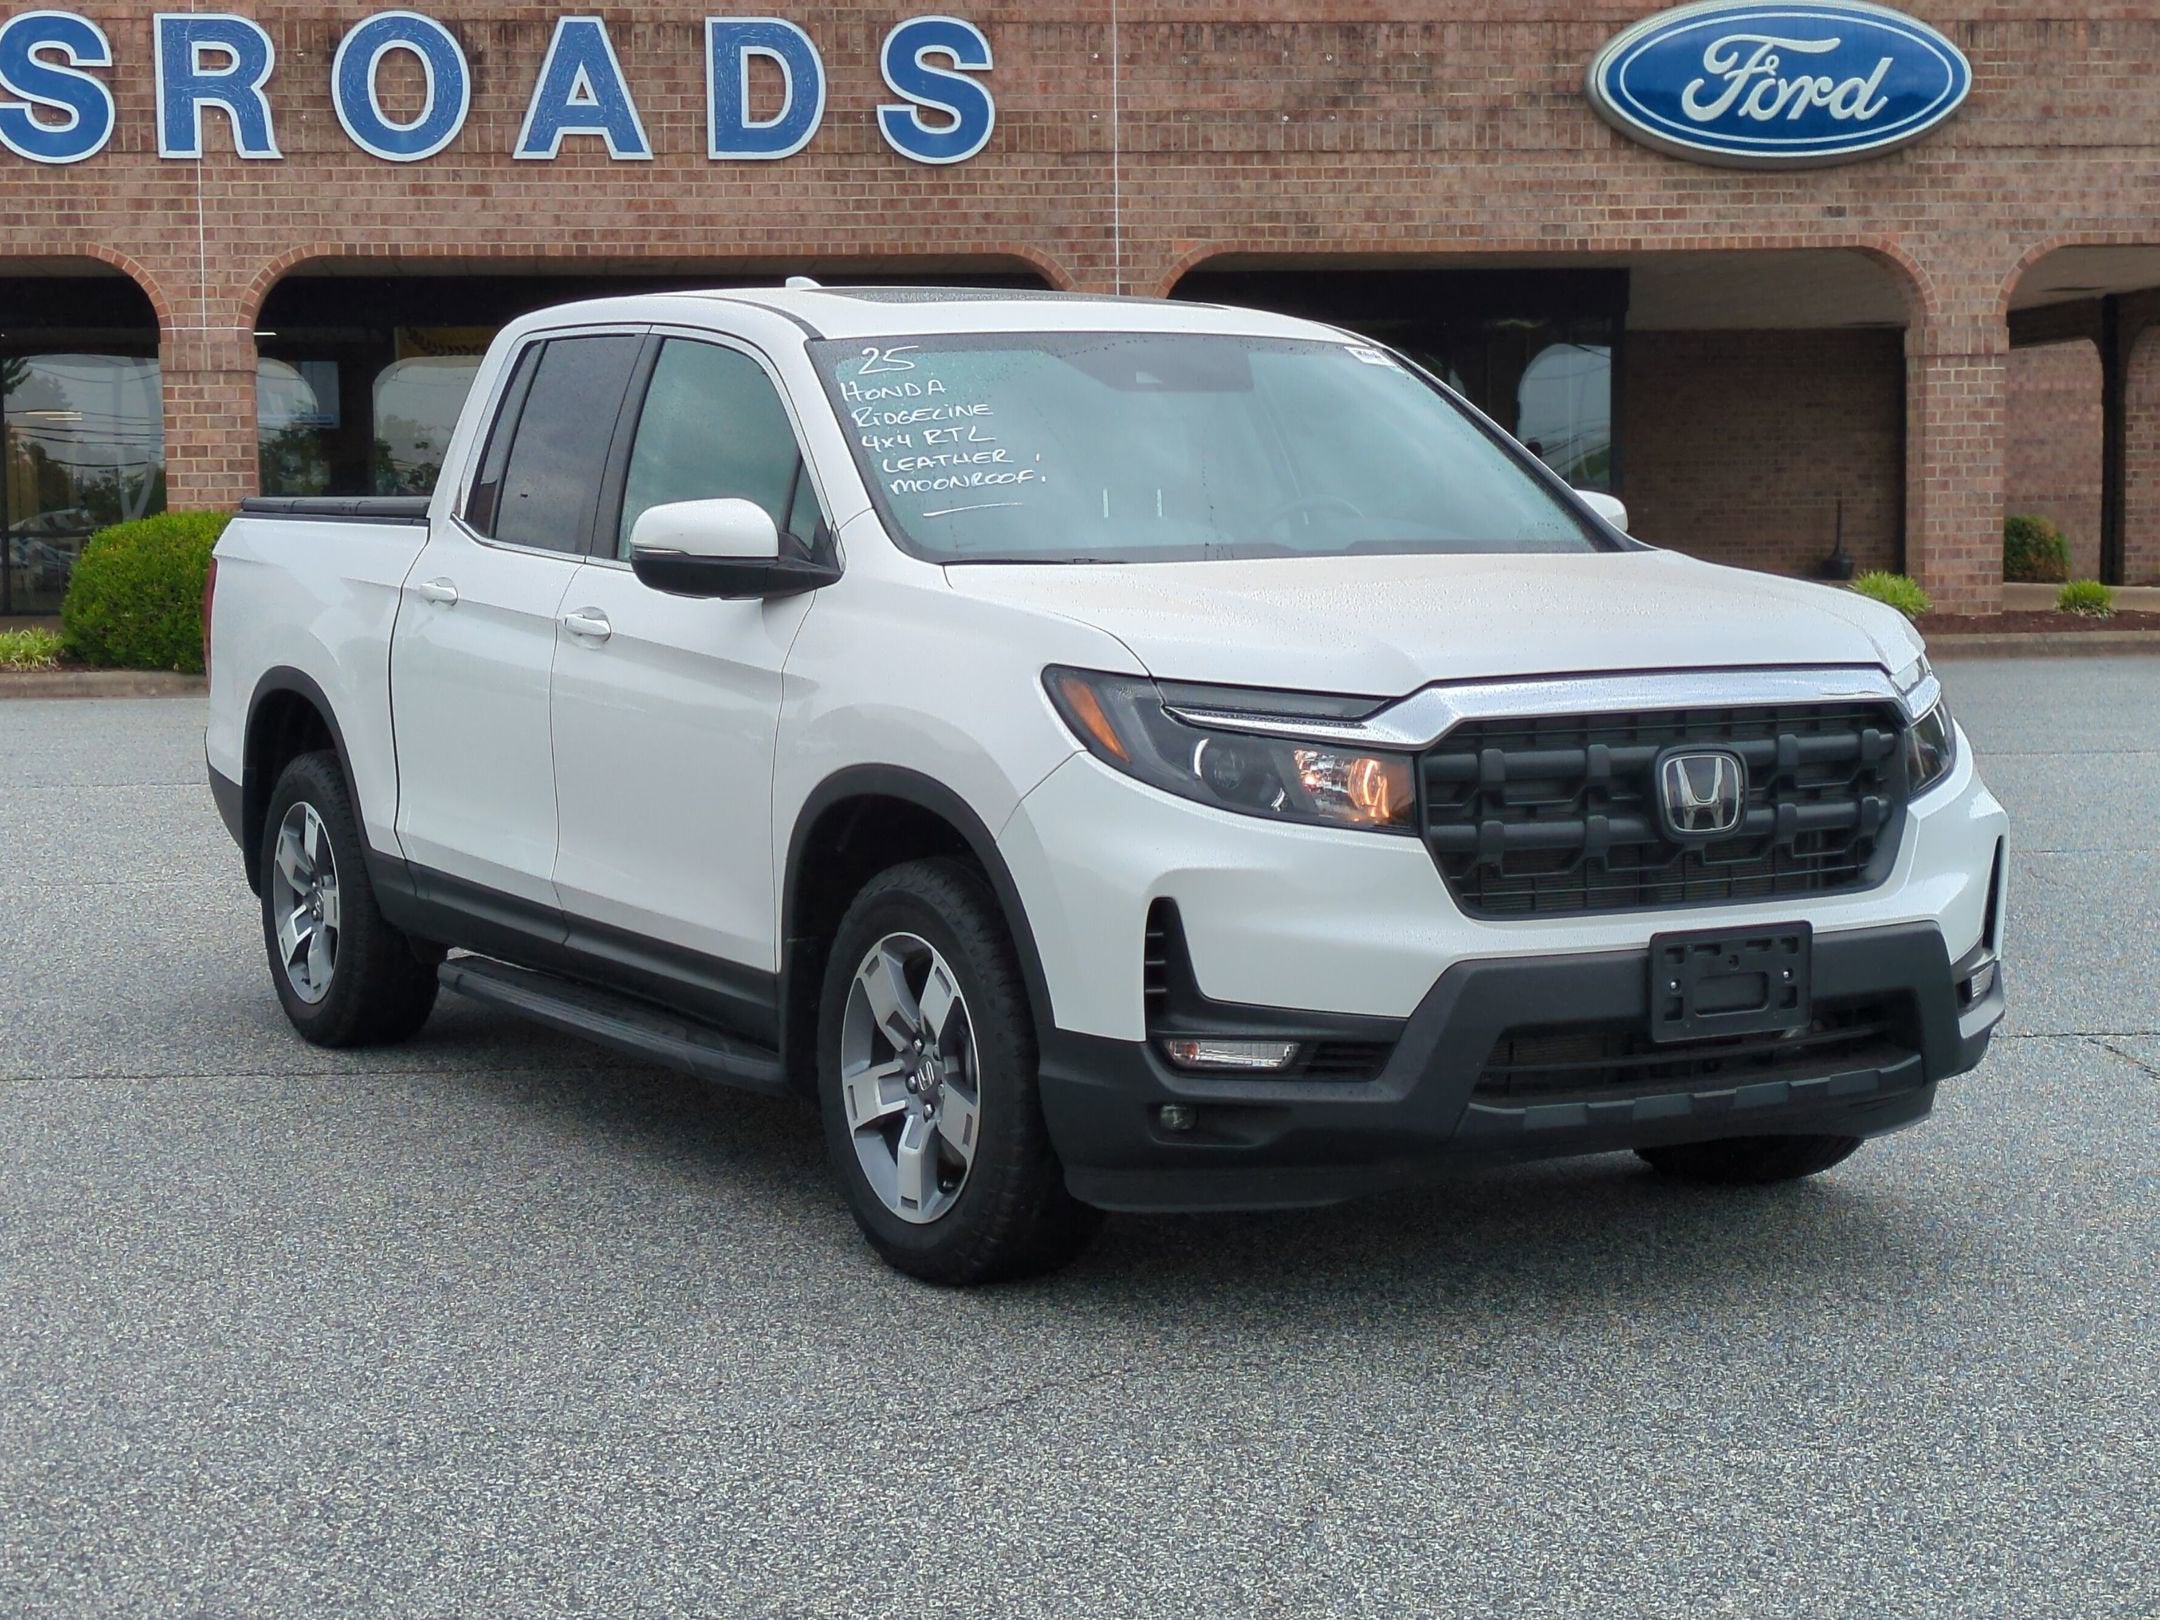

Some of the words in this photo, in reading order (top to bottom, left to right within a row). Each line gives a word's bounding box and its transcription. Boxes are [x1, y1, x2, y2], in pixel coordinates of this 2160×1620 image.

[0, 10, 996, 165] SROADS
[1681, 34, 1893, 121] Ford
[858, 345, 919, 375] 25
[840, 379, 947, 402] HONDA
[923, 426, 996, 446] RTL
[882, 448, 1014, 473] LEATHER
